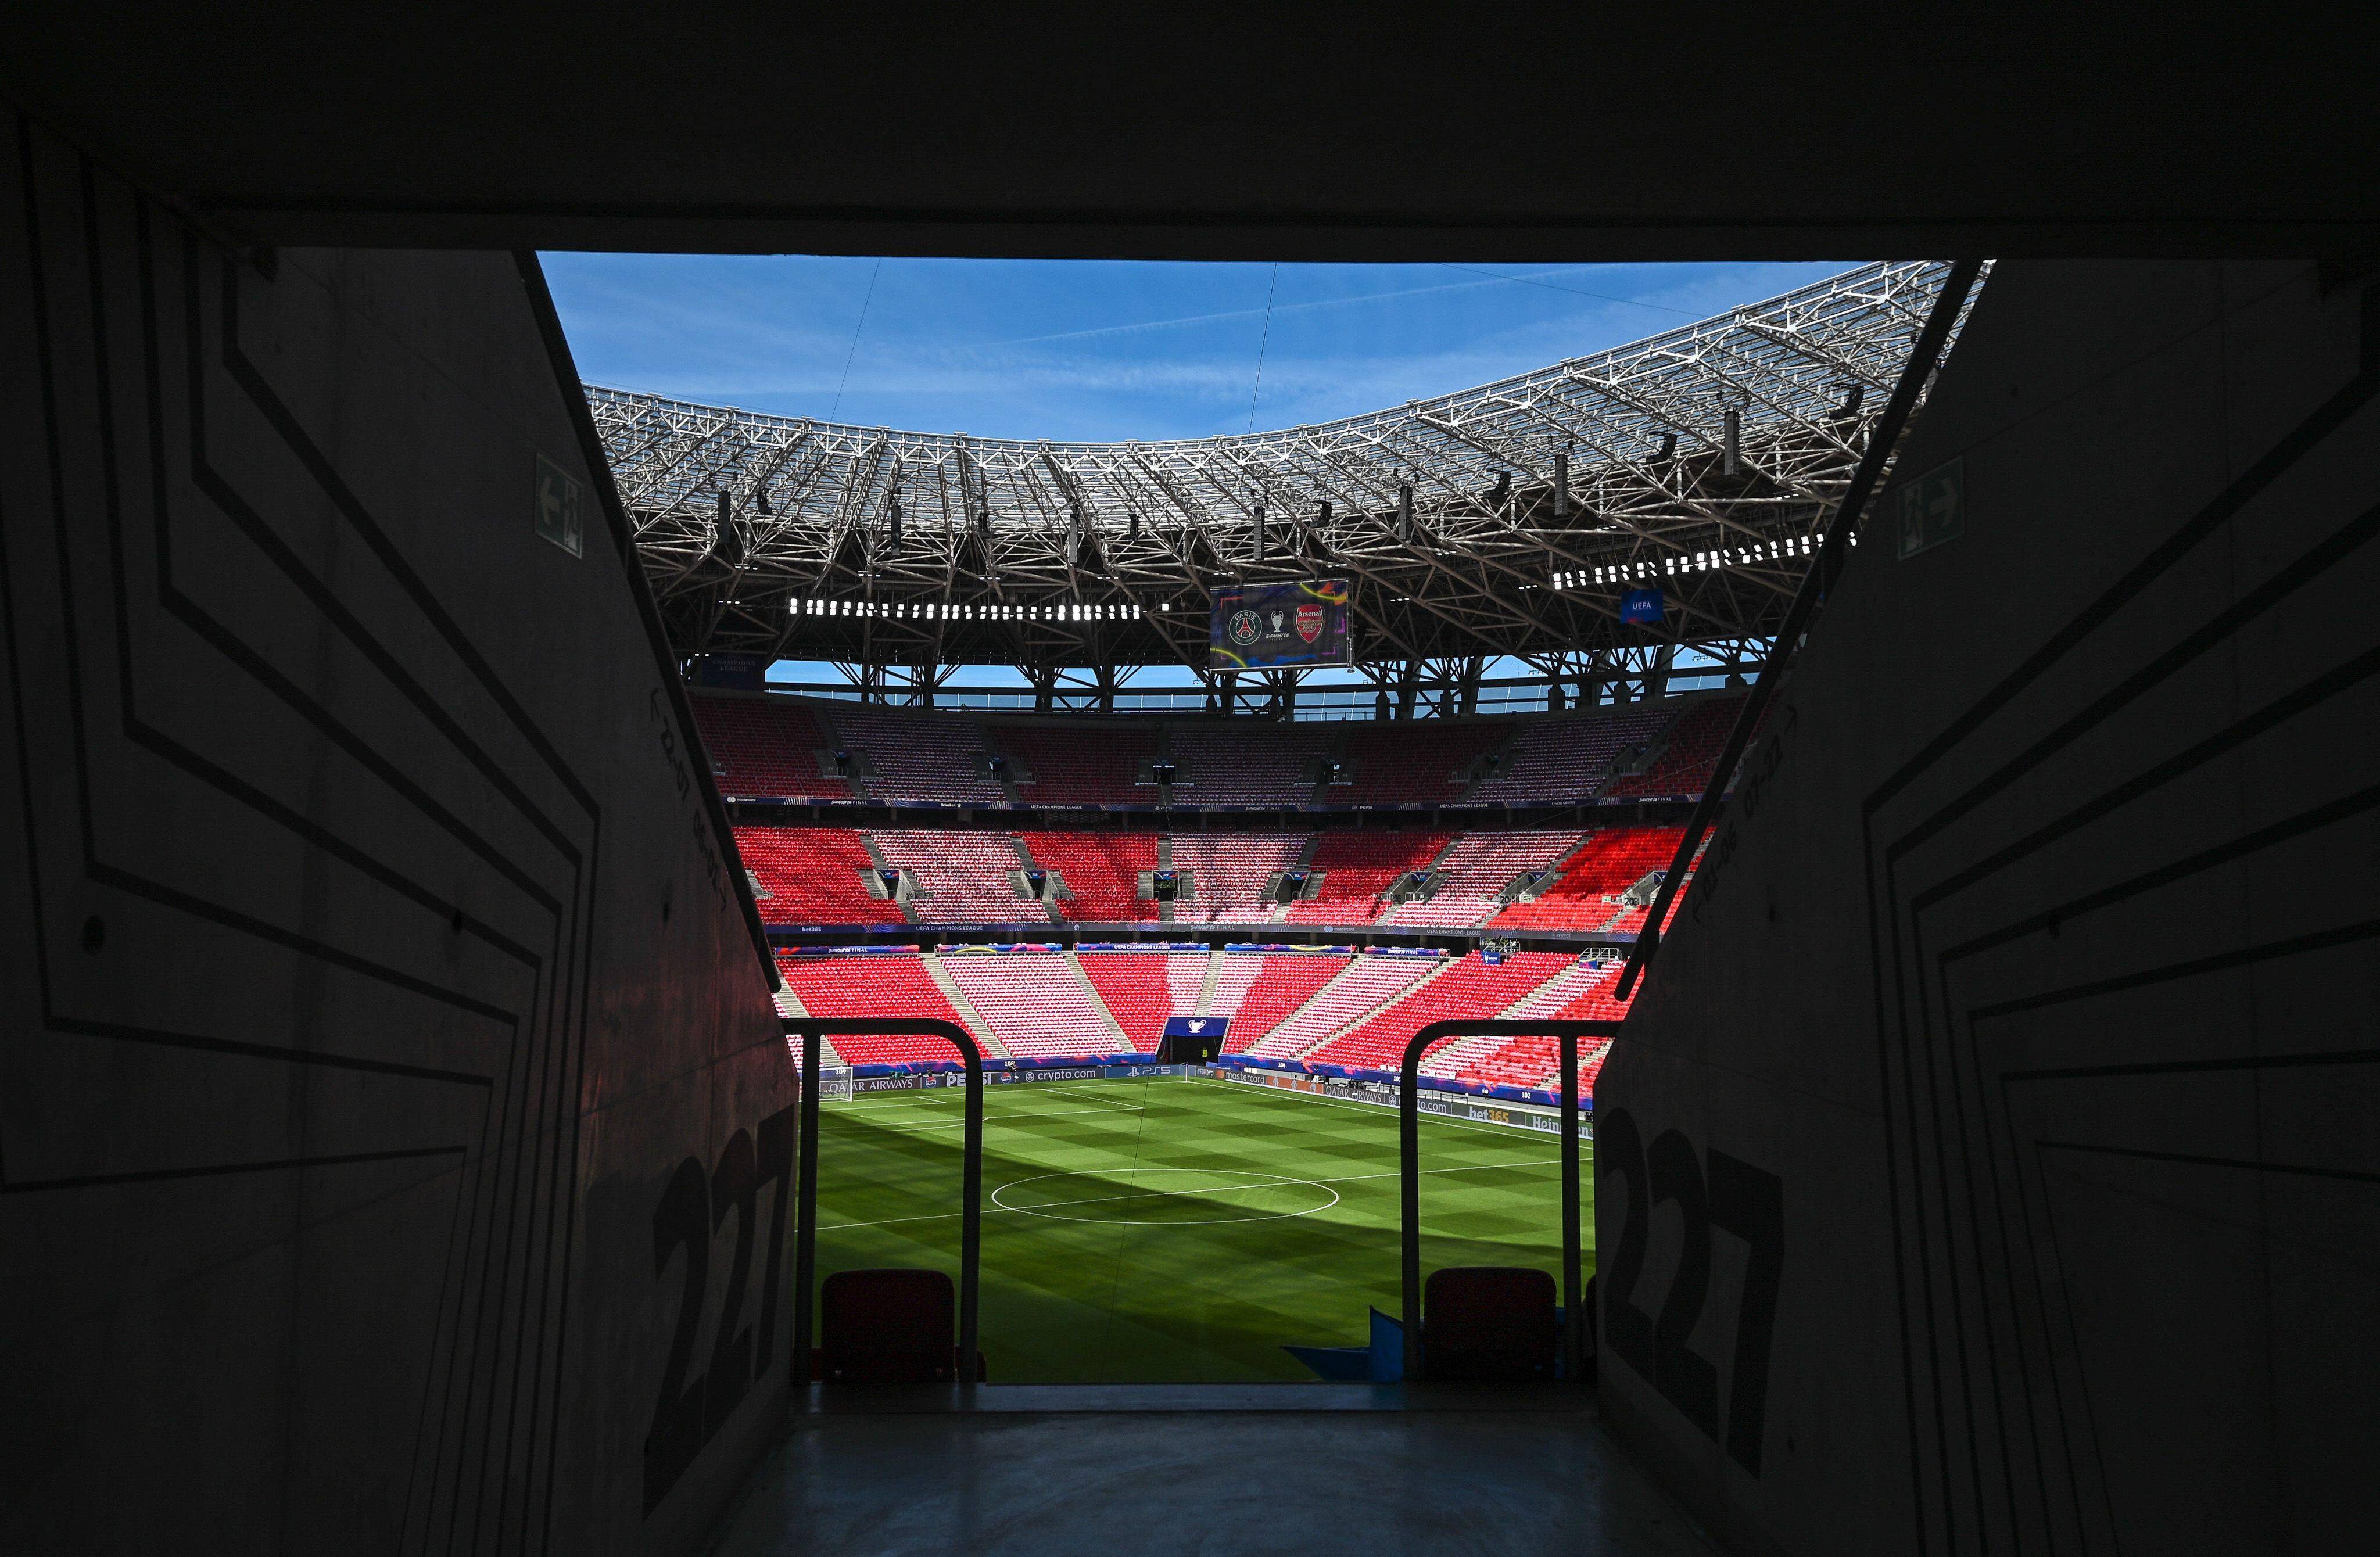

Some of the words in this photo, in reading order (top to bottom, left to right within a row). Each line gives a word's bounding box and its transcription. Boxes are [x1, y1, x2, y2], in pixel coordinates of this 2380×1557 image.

[1235, 611, 1256, 620] PARIS
[1037, 1068, 1096, 1082] crypto.com
[1142, 1066, 1171, 1075] PS5
[946, 1073, 992, 1087] PESI
[1225, 1071, 1265, 1084] mastercard
[869, 1079, 913, 1090] AIRWAYS
[1325, 1085, 1349, 1097] QATAR
[1469, 1106, 1510, 1123] bet365
[1599, 1107, 1784, 1482] 227
[641, 1103, 794, 1522] 227
